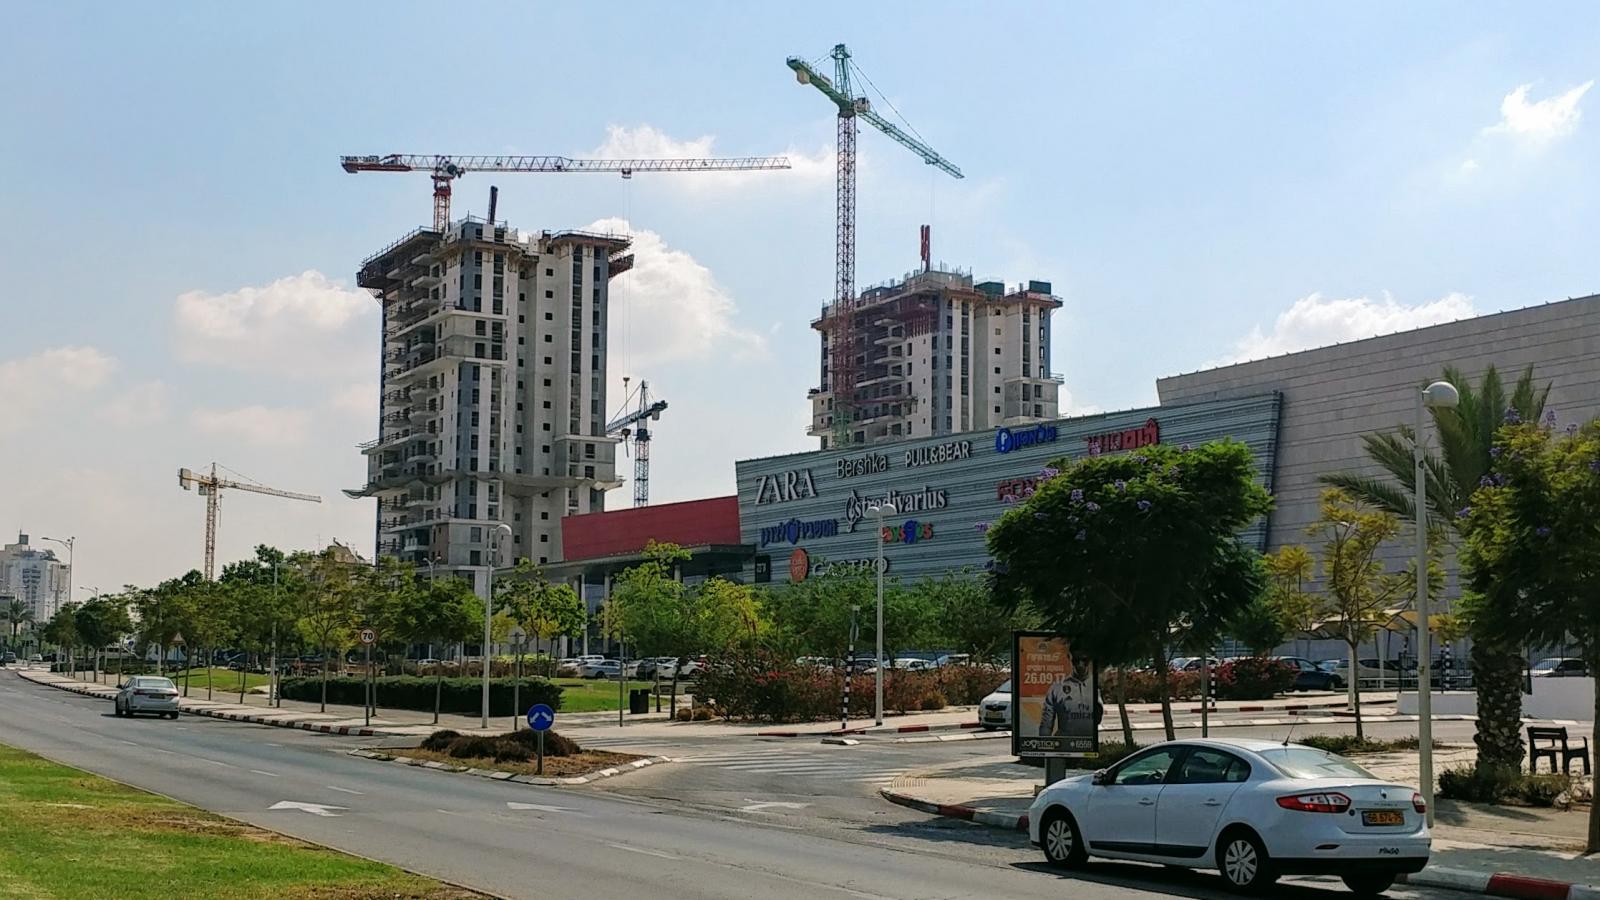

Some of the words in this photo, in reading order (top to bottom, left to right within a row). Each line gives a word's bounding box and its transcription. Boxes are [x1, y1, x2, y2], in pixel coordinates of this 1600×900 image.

[836, 454, 887, 479] Bershka
[904, 441, 971, 467] PULL&BEAR
[755, 469, 817, 505] ZARA
[362, 632, 373, 640] 70
